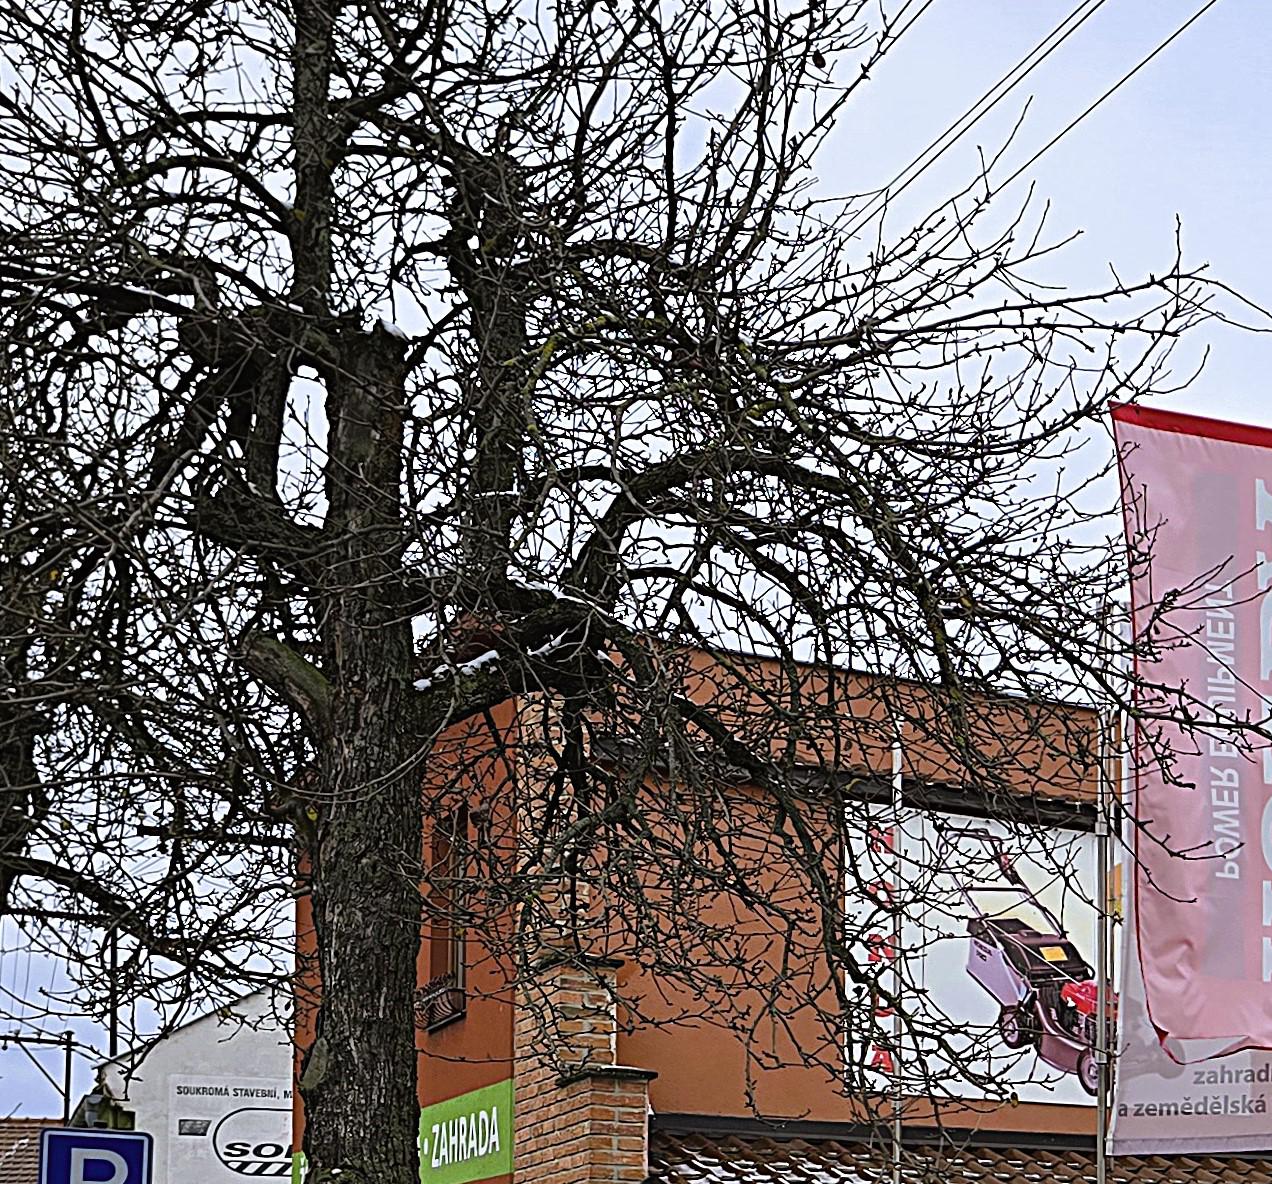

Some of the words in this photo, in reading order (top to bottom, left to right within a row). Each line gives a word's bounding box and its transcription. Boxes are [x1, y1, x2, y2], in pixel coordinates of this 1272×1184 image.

[176, 1085, 229, 1097] SOUKROMÁ
[1118, 1104, 1128, 1117] a
[1133, 1094, 1267, 1117] zemědělská
[431, 1106, 500, 1168] ZAHRADA
